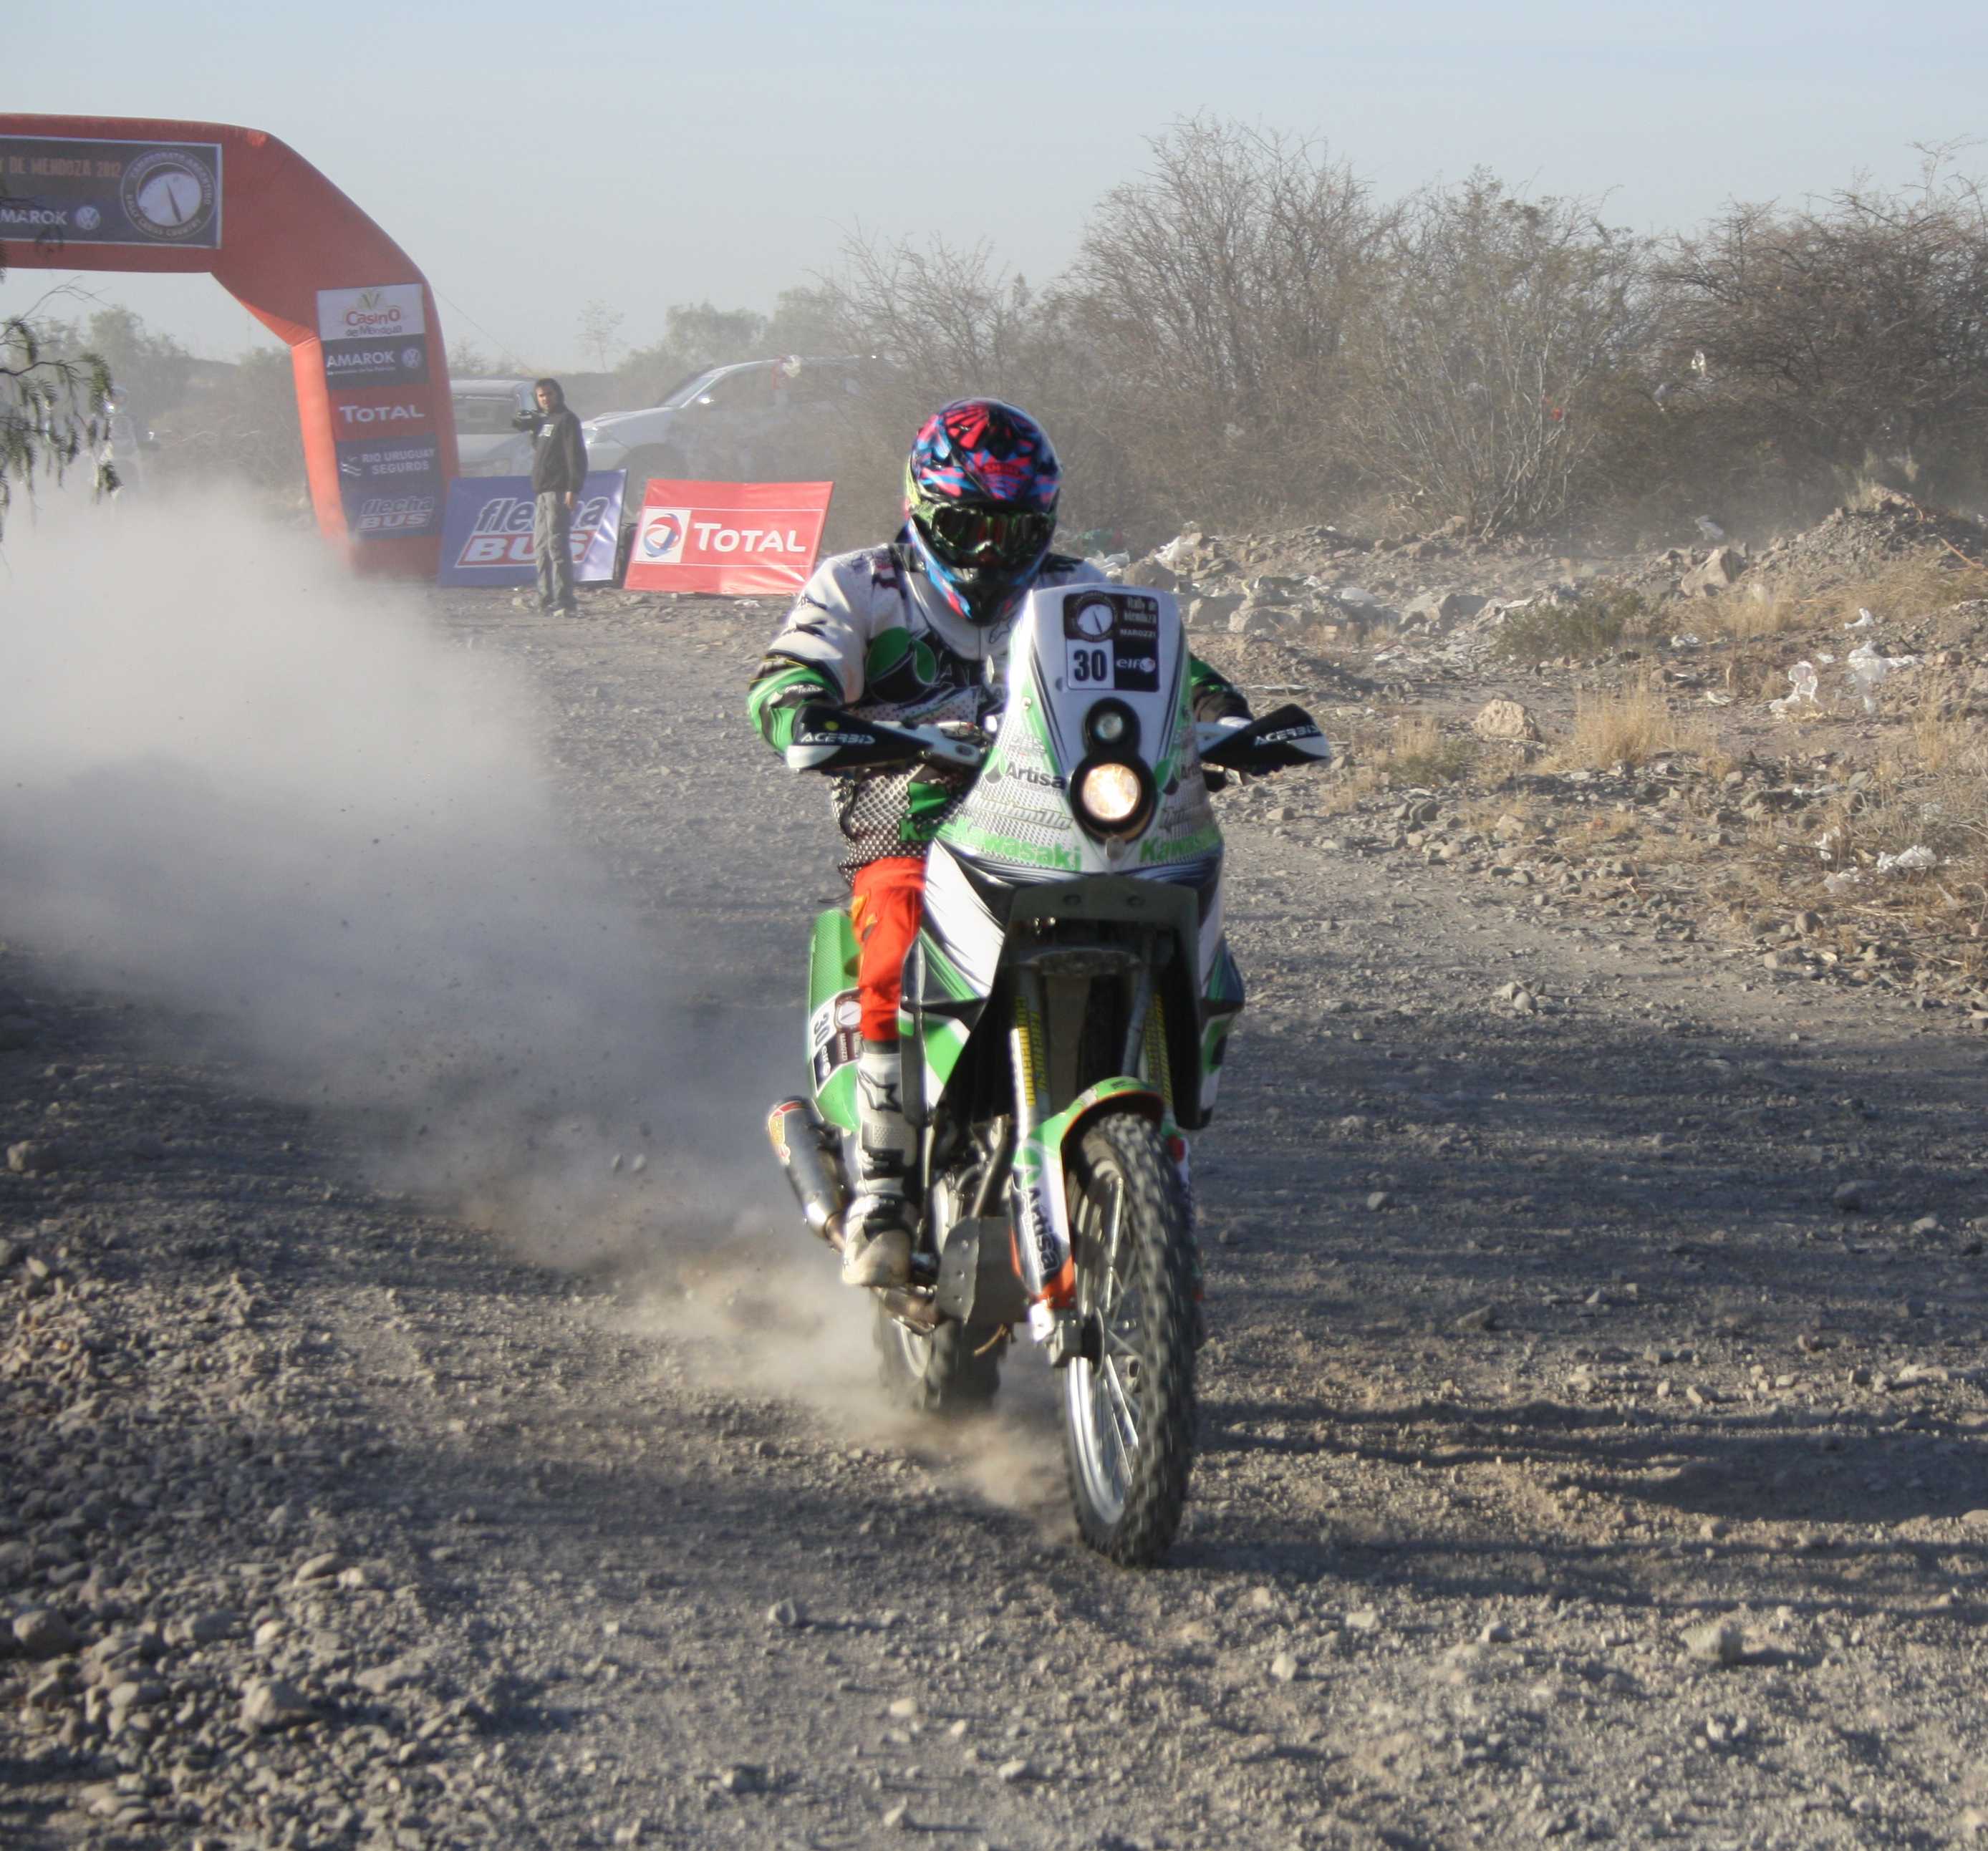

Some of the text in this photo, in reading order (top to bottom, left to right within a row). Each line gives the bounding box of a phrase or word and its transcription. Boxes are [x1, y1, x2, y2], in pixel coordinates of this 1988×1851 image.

[9, 155, 121, 178] DE MENDOZA 2012
[327, 350, 396, 367] AMAROK
[339, 404, 425, 423] TOTAL
[362, 448, 435, 463] RIO URUGUAY
[372, 460, 430, 475] SEGUROS
[360, 513, 428, 529] BUS
[693, 522, 807, 553] TOTAL
[1073, 649, 1108, 682] 30
[1115, 657, 1141, 670] elf
[800, 732, 877, 745] ACERBIS
[1255, 725, 1321, 746] ACERBIS
[1005, 760, 1067, 791] Artisa
[951, 815, 1081, 871] Kawasaki
[814, 1011, 830, 1047] 30
